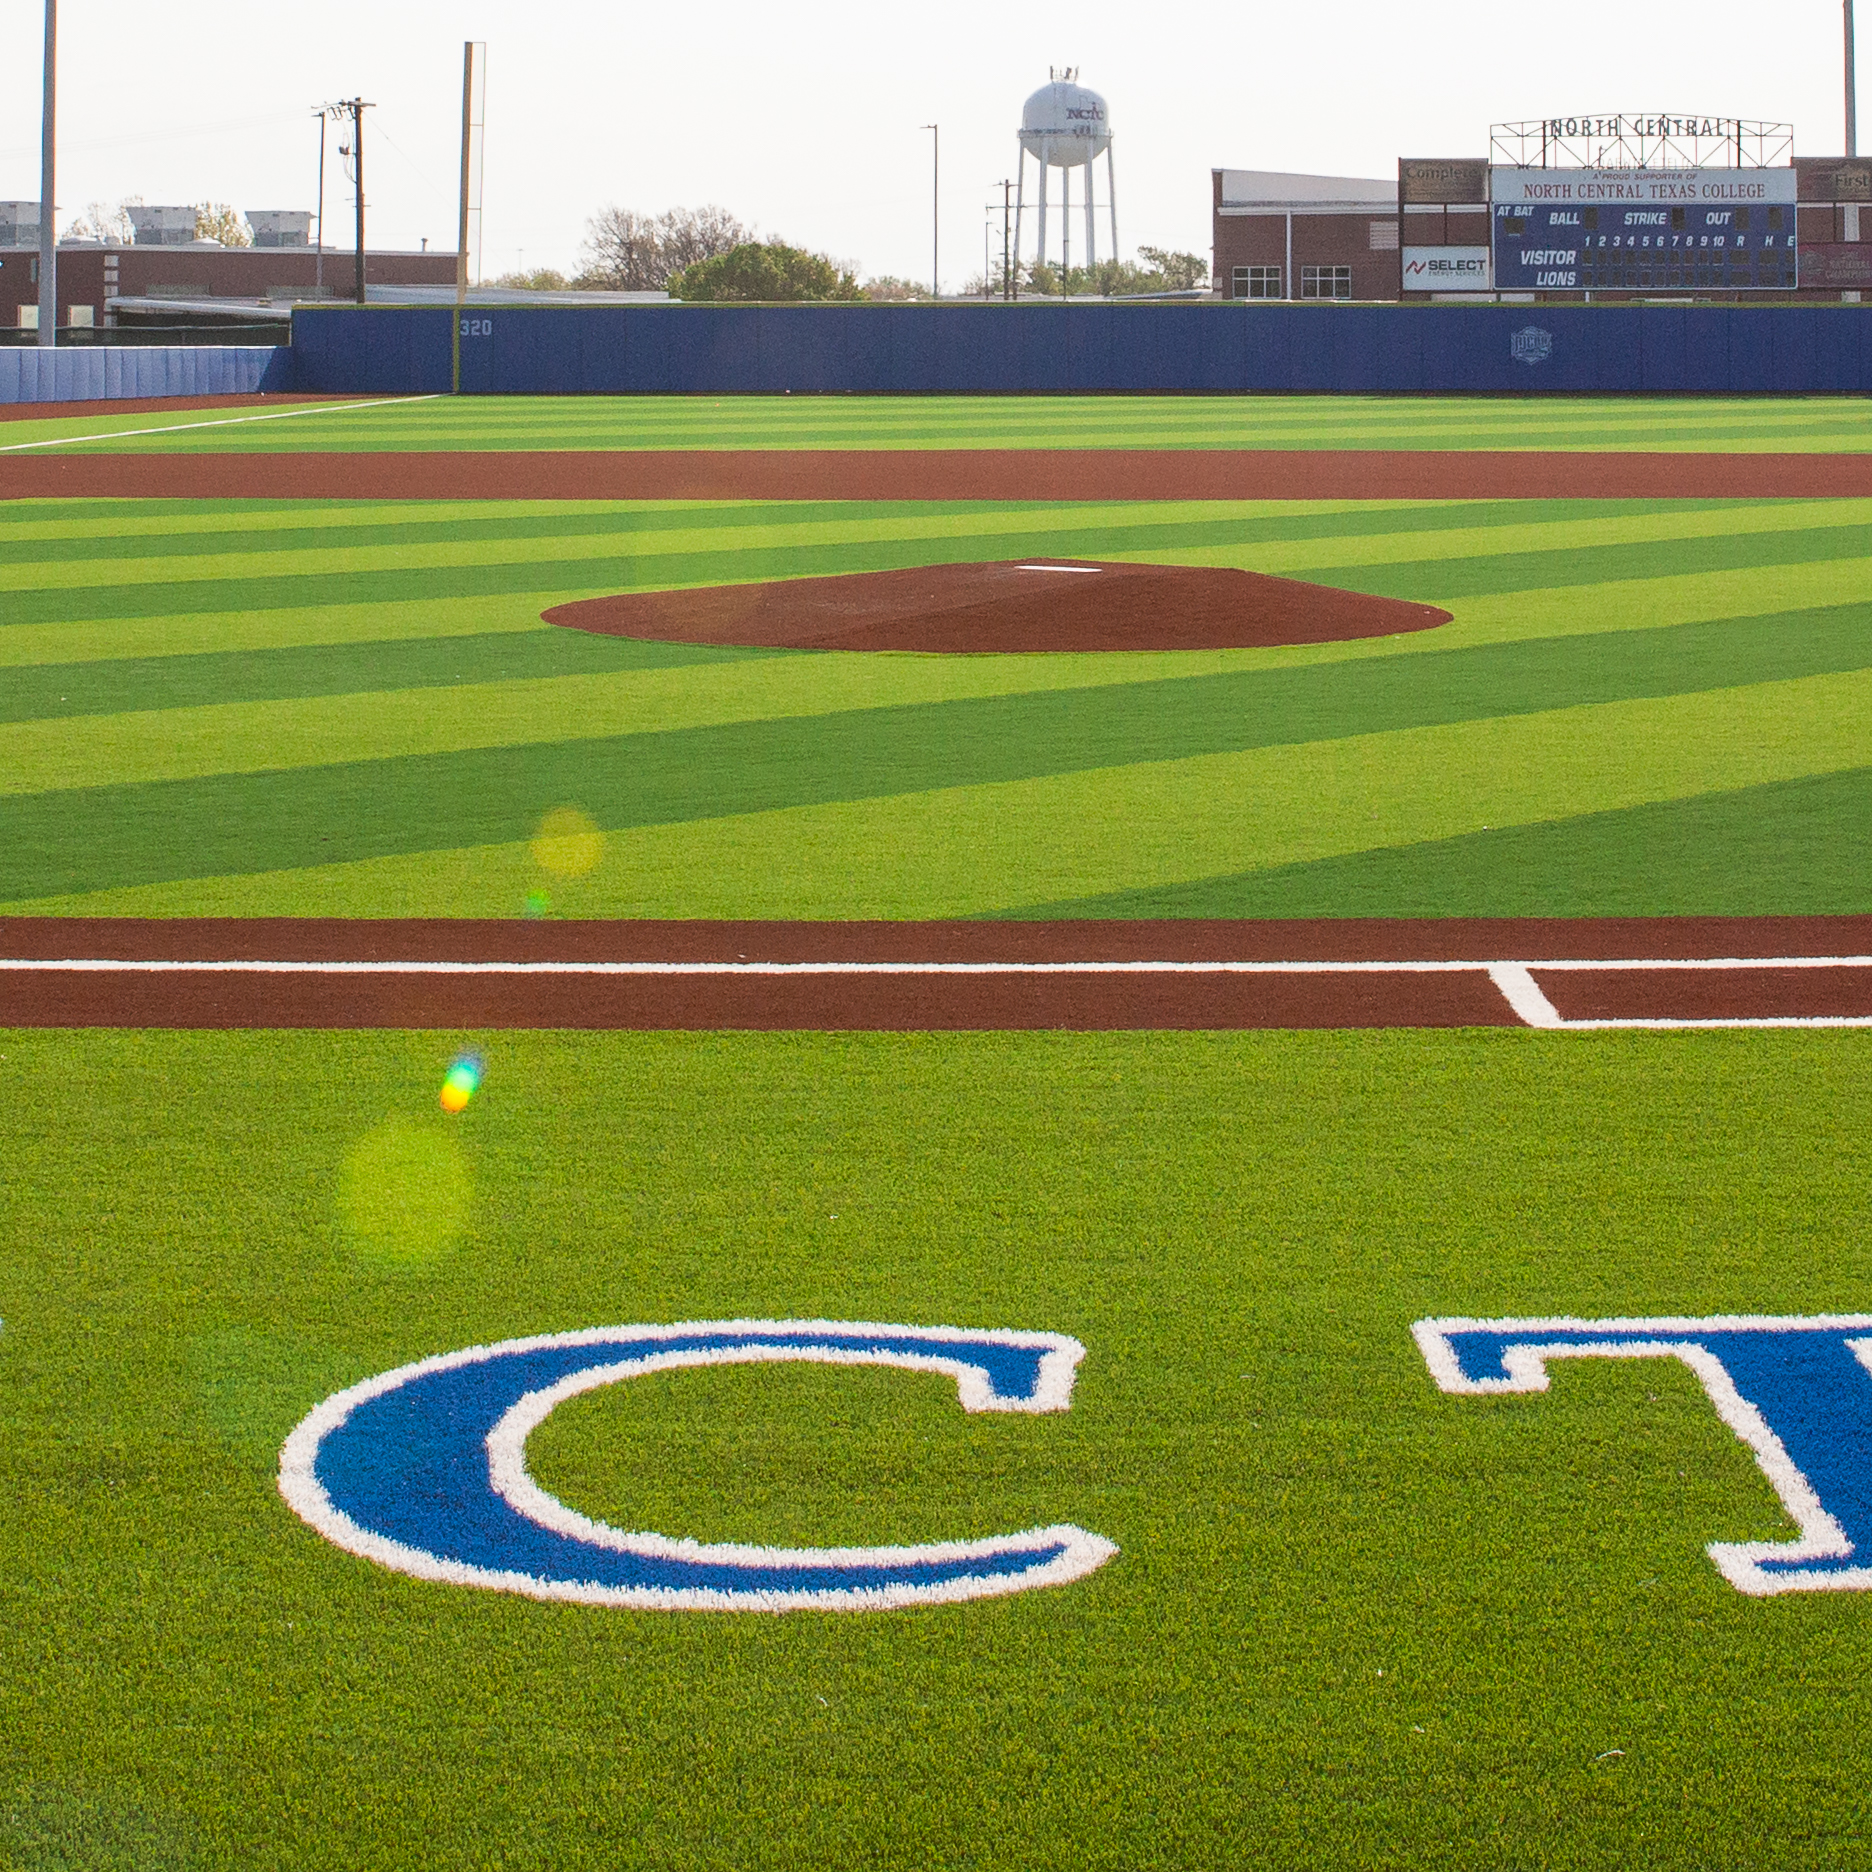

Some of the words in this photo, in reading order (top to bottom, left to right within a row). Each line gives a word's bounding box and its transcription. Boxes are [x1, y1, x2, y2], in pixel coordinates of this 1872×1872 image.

[1550, 118, 1620, 137] NORTH
[1634, 117, 1724, 137] CENTRAL
[1592, 172, 1599, 180] A
[1601, 172, 1631, 180] PROUD
[1633, 172, 1683, 180] SUPPORTER
[1685, 172, 1698, 180] OF
[1835, 173, 1869, 187] First
[1524, 183, 1572, 199] NORTH
[1577, 183, 1645, 199] CENTRAL
[1649, 183, 1697, 199] TEXAS
[1701, 183, 1766, 199] COLLEGE
[1497, 205, 1512, 217] AT
[1514, 205, 1535, 217] BAT
[1706, 211, 1732, 225] OUT
[1549, 212, 1580, 225] BALL
[1624, 212, 1667, 225] STRIKE
[1585, 235, 1591, 247] 1
[1598, 235, 1607, 247] 2
[1612, 235, 1621, 247] 3
[1626, 235, 1635, 247] 4
[1642, 235, 1650, 247] 5
[1656, 235, 1665, 247] 6
[1671, 235, 1679, 247] 7
[1685, 235, 1694, 247] 8
[1699, 235, 1708, 247] 9
[1712, 235, 1725, 247] 10
[1736, 235, 1746, 247] R
[1764, 235, 1774, 247] H
[1787, 235, 1795, 247] E
[1428, 259, 1486, 270] SELECT
[1520, 249, 1577, 266] VISITOR
[1535, 271, 1577, 286] LIONS
[459, 319, 493, 336] 320
